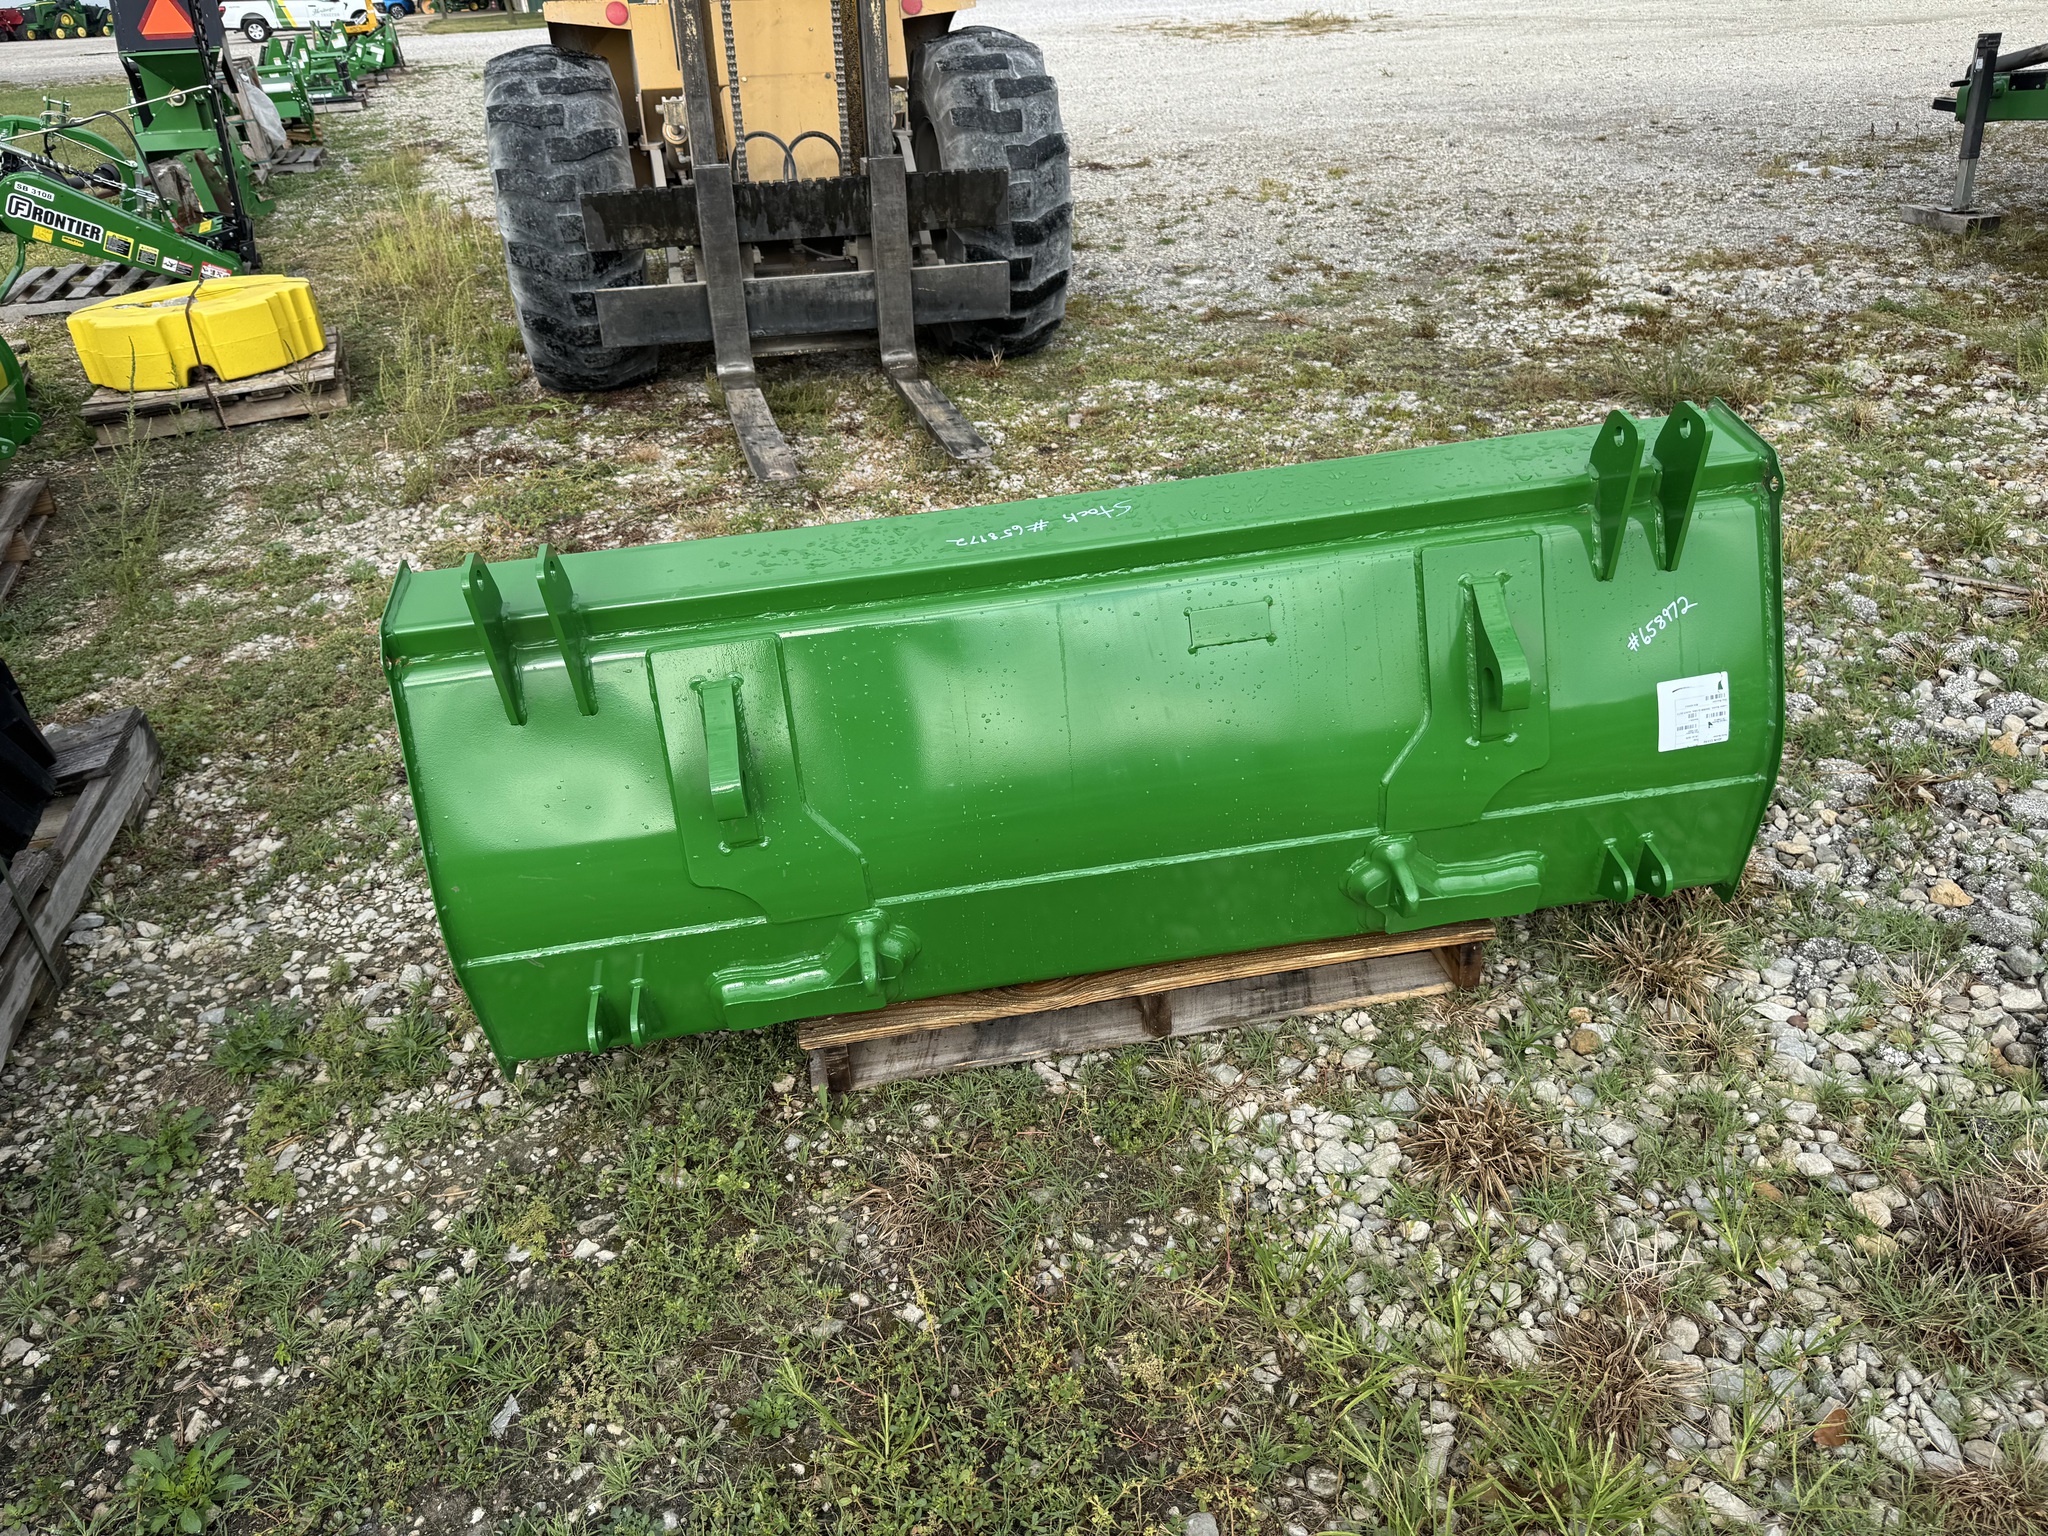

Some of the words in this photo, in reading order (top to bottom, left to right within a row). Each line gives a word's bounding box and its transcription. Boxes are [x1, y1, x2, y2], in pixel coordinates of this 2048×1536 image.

[16, 183, 29, 192] SB
[31, 188, 53, 200] 3108
[8, 195, 101, 242] FRONTIER
[1062, 499, 1132, 523] Stock
[1627, 596, 1698, 652] #658972
